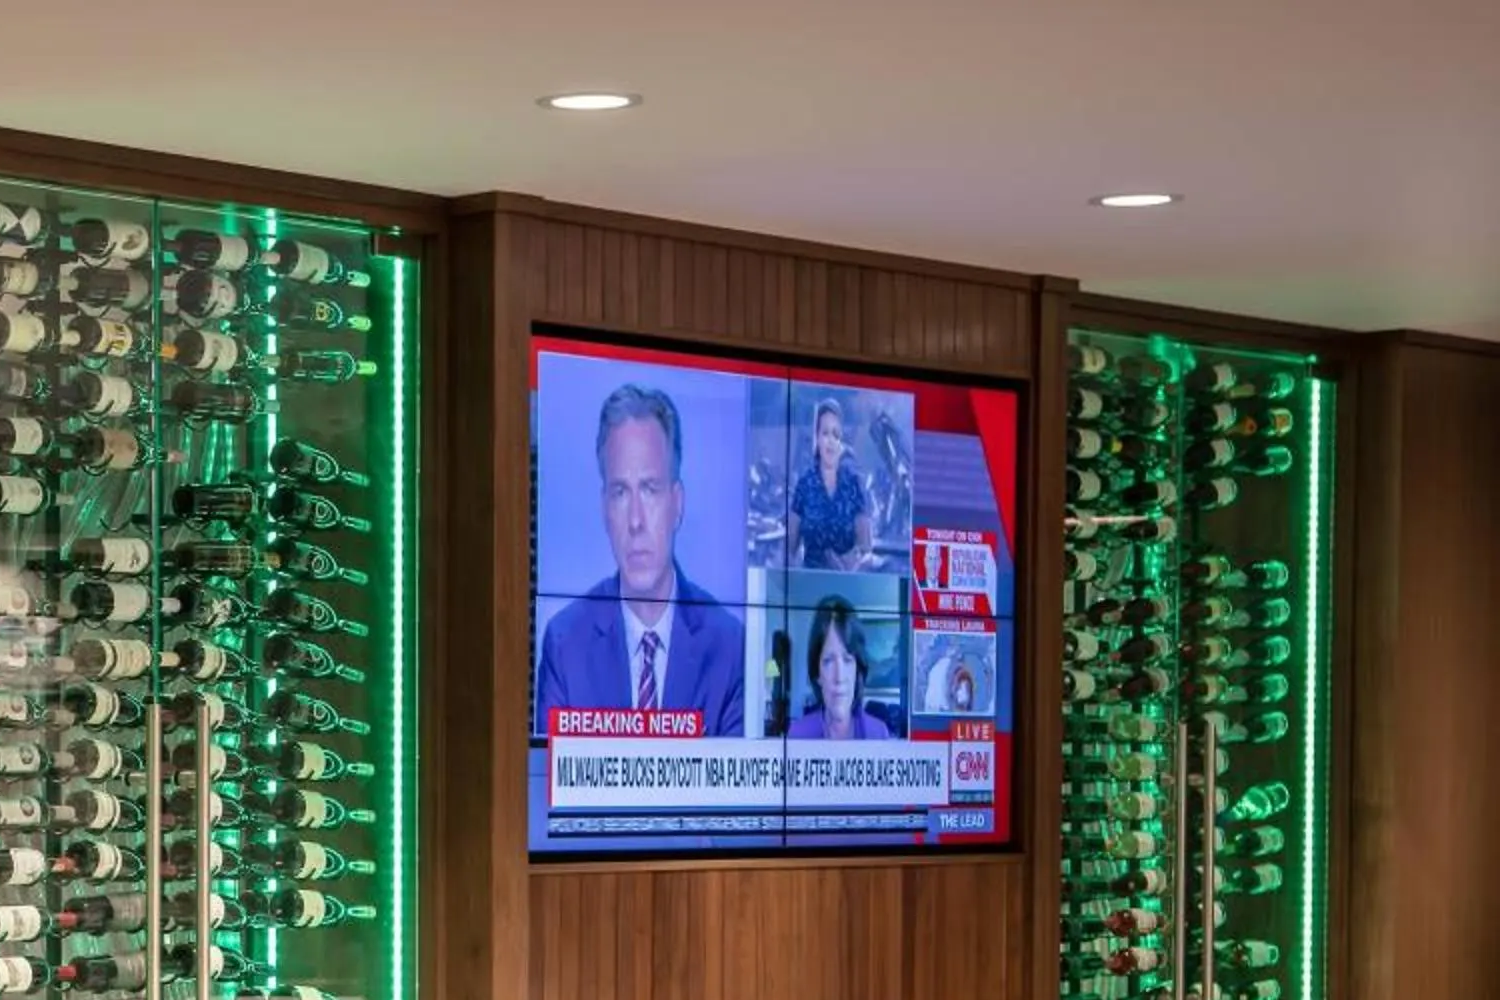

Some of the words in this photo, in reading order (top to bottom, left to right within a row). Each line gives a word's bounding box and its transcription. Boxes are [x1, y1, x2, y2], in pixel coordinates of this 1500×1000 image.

[558, 711, 645, 734] BREAKING
[650, 712, 697, 736] NEWS
[956, 722, 989, 739] LIVE
[557, 757, 619, 788] MILWAUKEE
[621, 756, 655, 788] BUCKS
[657, 757, 703, 788] BOYCOTT
[705, 758, 725, 788] NBA
[727, 758, 769, 788] PLAYOFF
[771, 758, 801, 788] GAME
[803, 759, 833, 788] AFTER
[834, 759, 864, 788] JACOB
[866, 759, 895, 788] BLAKE
[897, 759, 941, 788] SHOOTING
[955, 751, 990, 781] CNN
[940, 812, 959, 829] THE
[960, 812, 985, 829] LEAD
